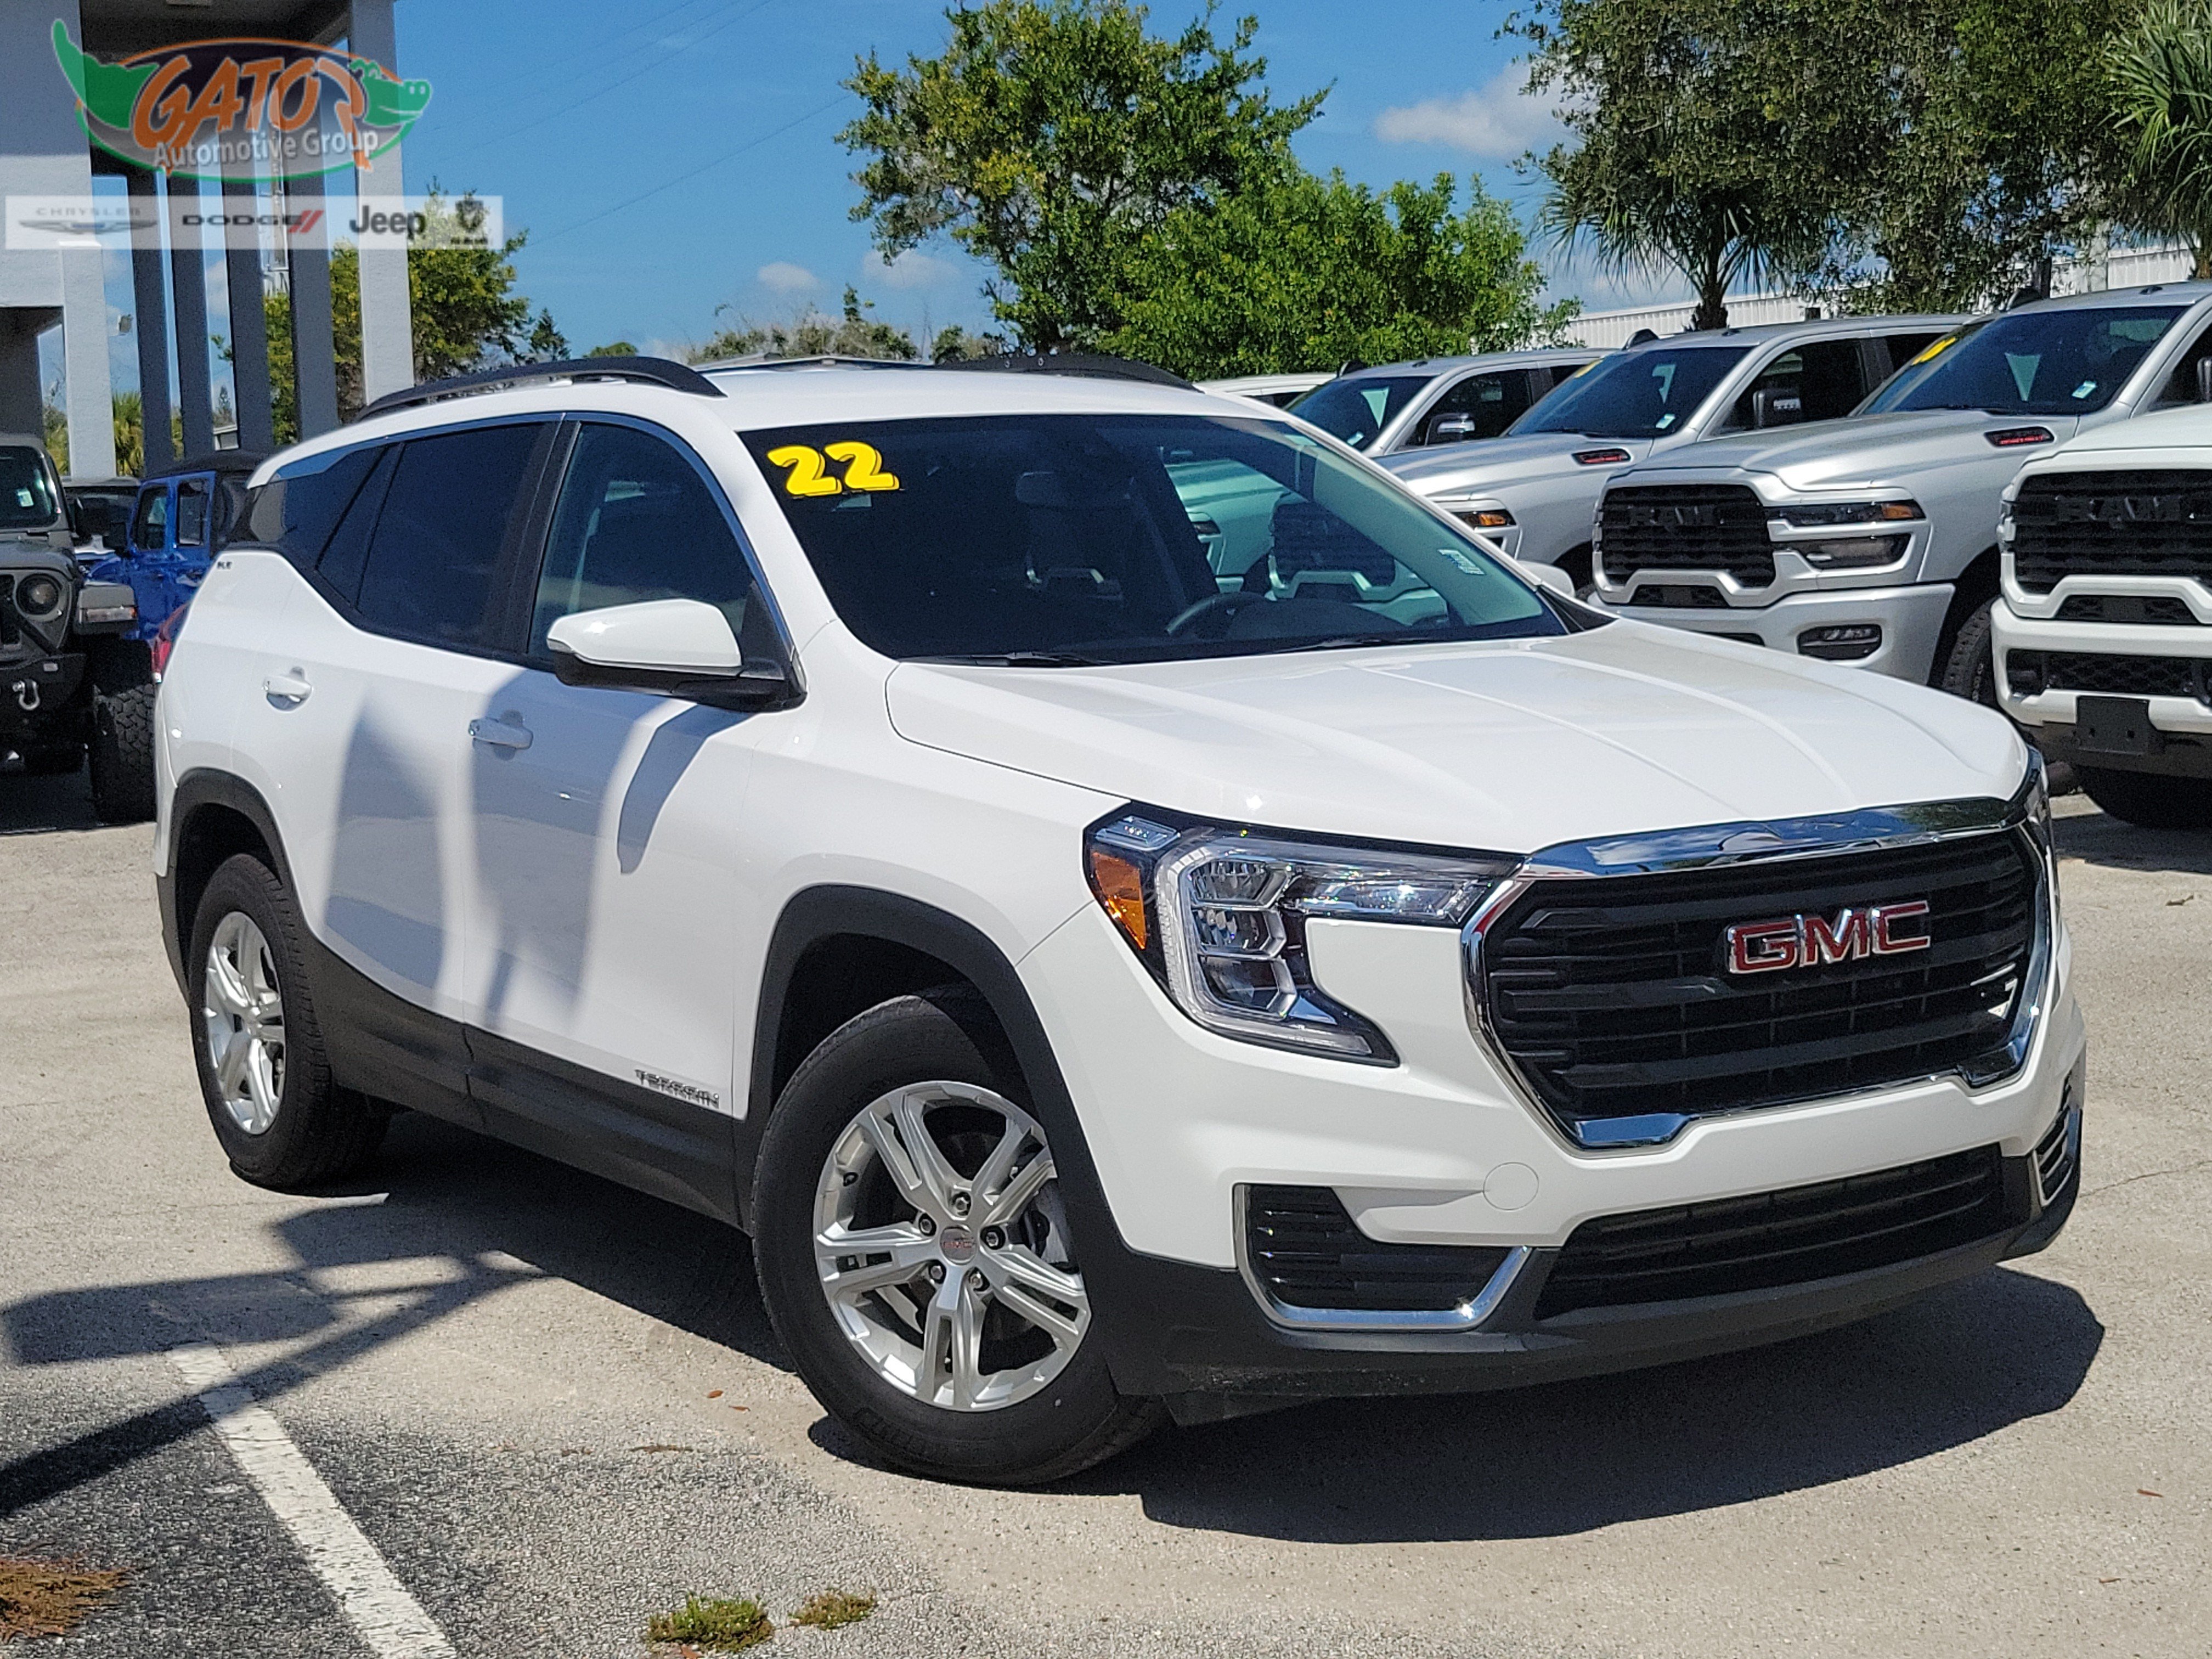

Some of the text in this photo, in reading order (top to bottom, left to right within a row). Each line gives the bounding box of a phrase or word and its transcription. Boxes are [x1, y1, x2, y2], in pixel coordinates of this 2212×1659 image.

[768, 441, 900, 496] 22
[1728, 900, 1931, 974] GMC
[635, 1069, 719, 1109] TERRAIN
